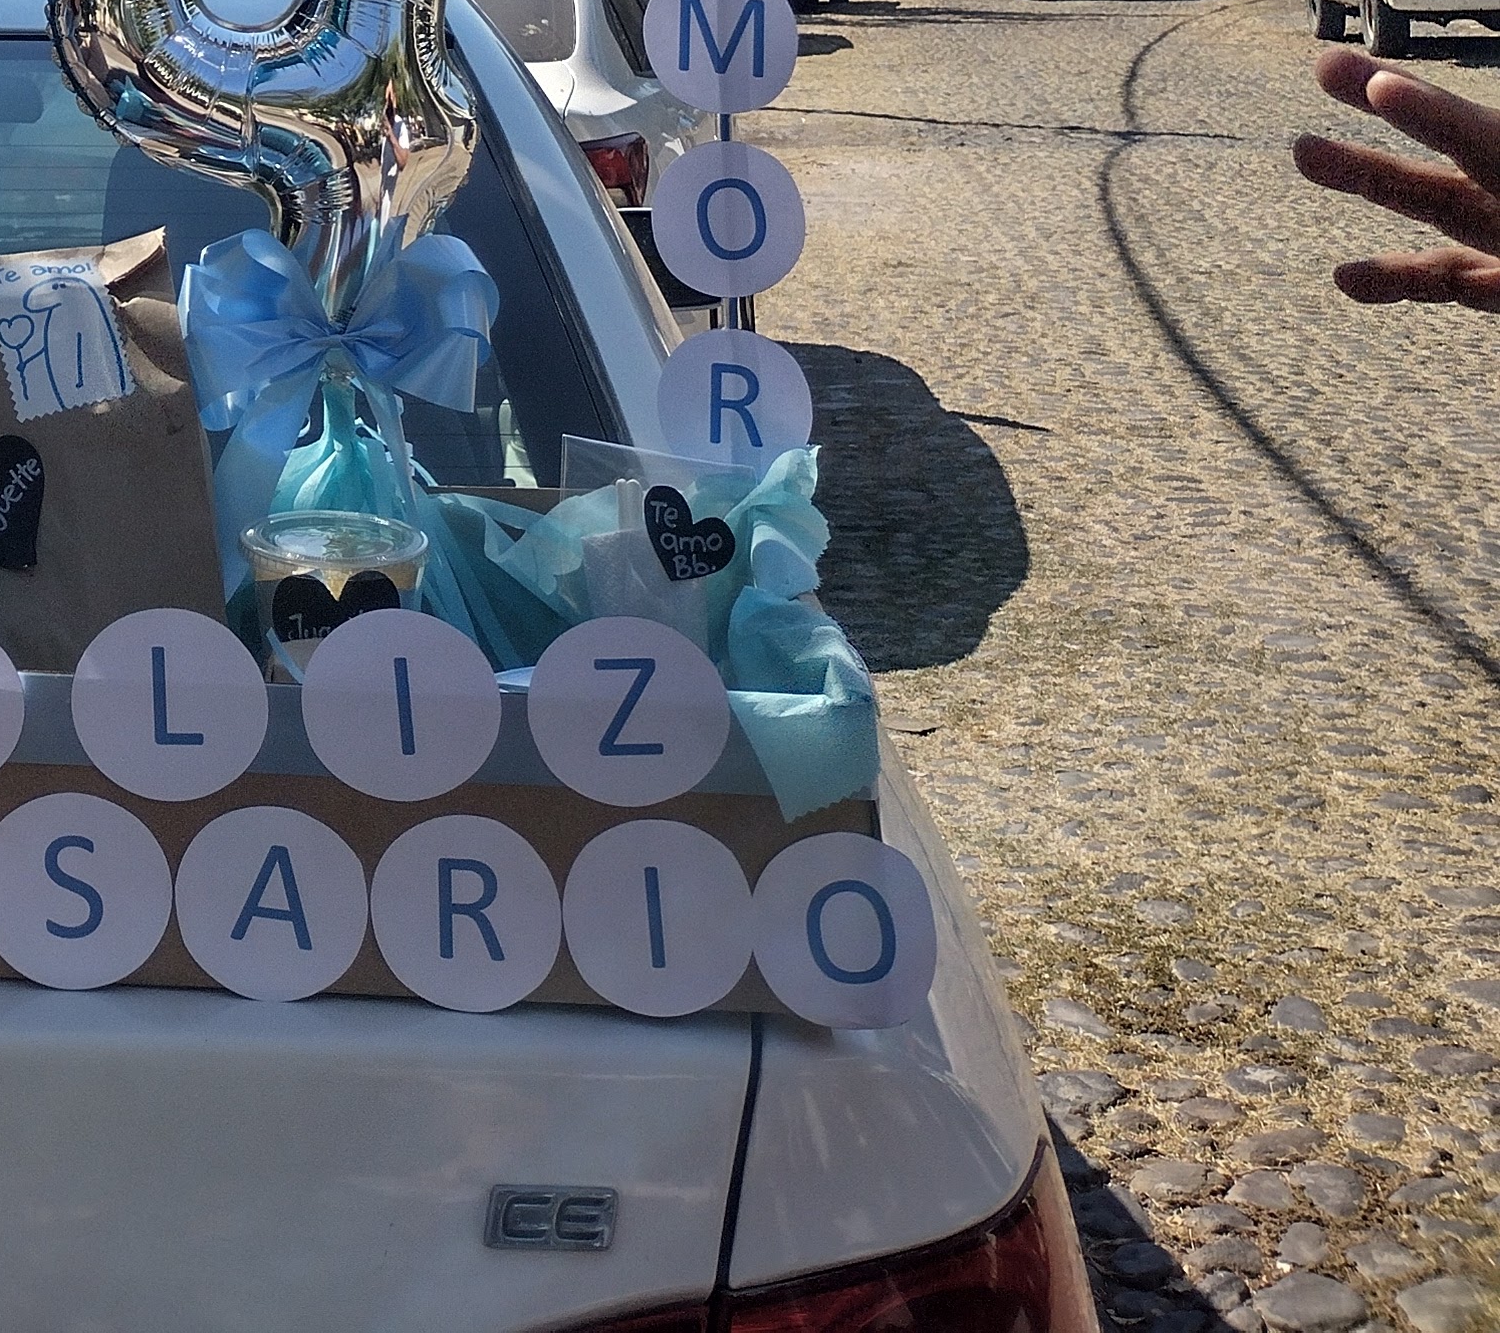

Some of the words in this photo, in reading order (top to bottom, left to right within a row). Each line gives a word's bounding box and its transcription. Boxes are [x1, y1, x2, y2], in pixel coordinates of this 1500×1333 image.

[29, 262, 93, 278] amo!
[650, 500, 679, 528] Te
[659, 532, 723, 554] amo
[500, 1194, 610, 1242] CE
